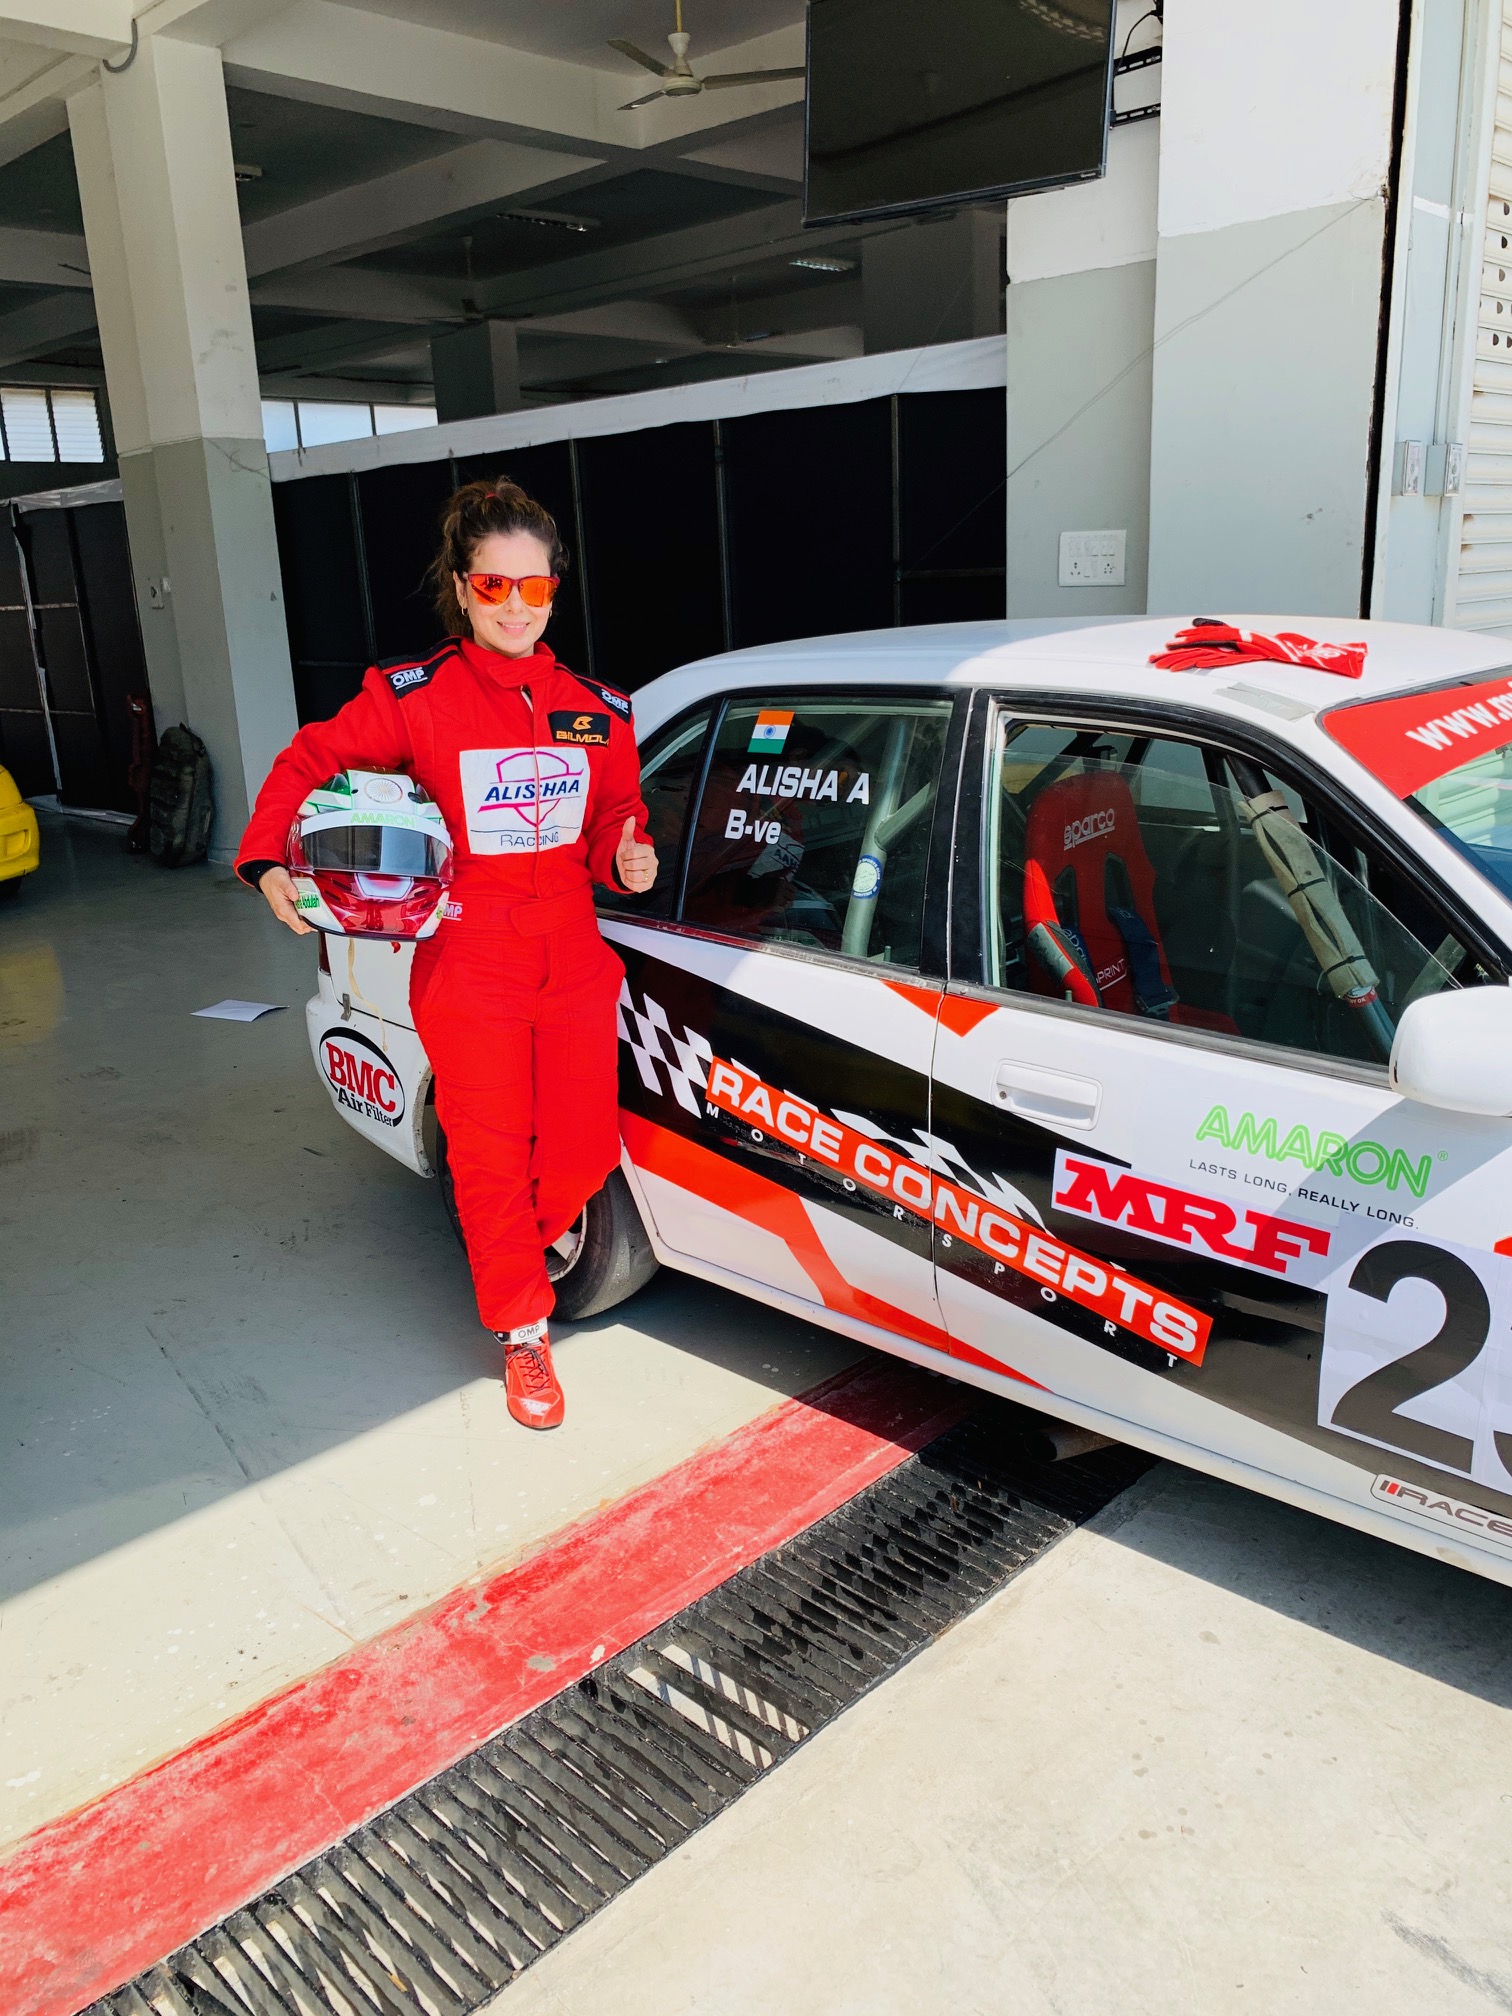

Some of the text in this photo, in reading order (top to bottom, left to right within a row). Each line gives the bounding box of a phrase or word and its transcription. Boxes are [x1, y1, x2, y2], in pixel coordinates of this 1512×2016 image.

[392, 669, 425, 686] OMP
[601, 690, 629, 709] OMP
[1404, 681, 1512, 751] www.m
[736, 764, 869, 805] ALISHA A
[351, 812, 415, 829] AMARON
[725, 809, 781, 845] B-ve
[1063, 808, 1115, 848] sparco
[444, 904, 462, 918] MP
[1096, 958, 1125, 984] PRINT
[325, 1041, 396, 1113] BMC
[338, 1087, 392, 1127] Air Filter
[711, 1063, 1198, 1354] RACE CONCEPTS
[1189, 1159, 1237, 1180] LASTS
[1298, 1188, 1360, 1212] REALLY
[1366, 1206, 1419, 1230] LONG.
[1056, 1158, 1332, 1274] MRF
[518, 1325, 541, 1338] OMP
[1330, 1239, 1512, 1478] 2
